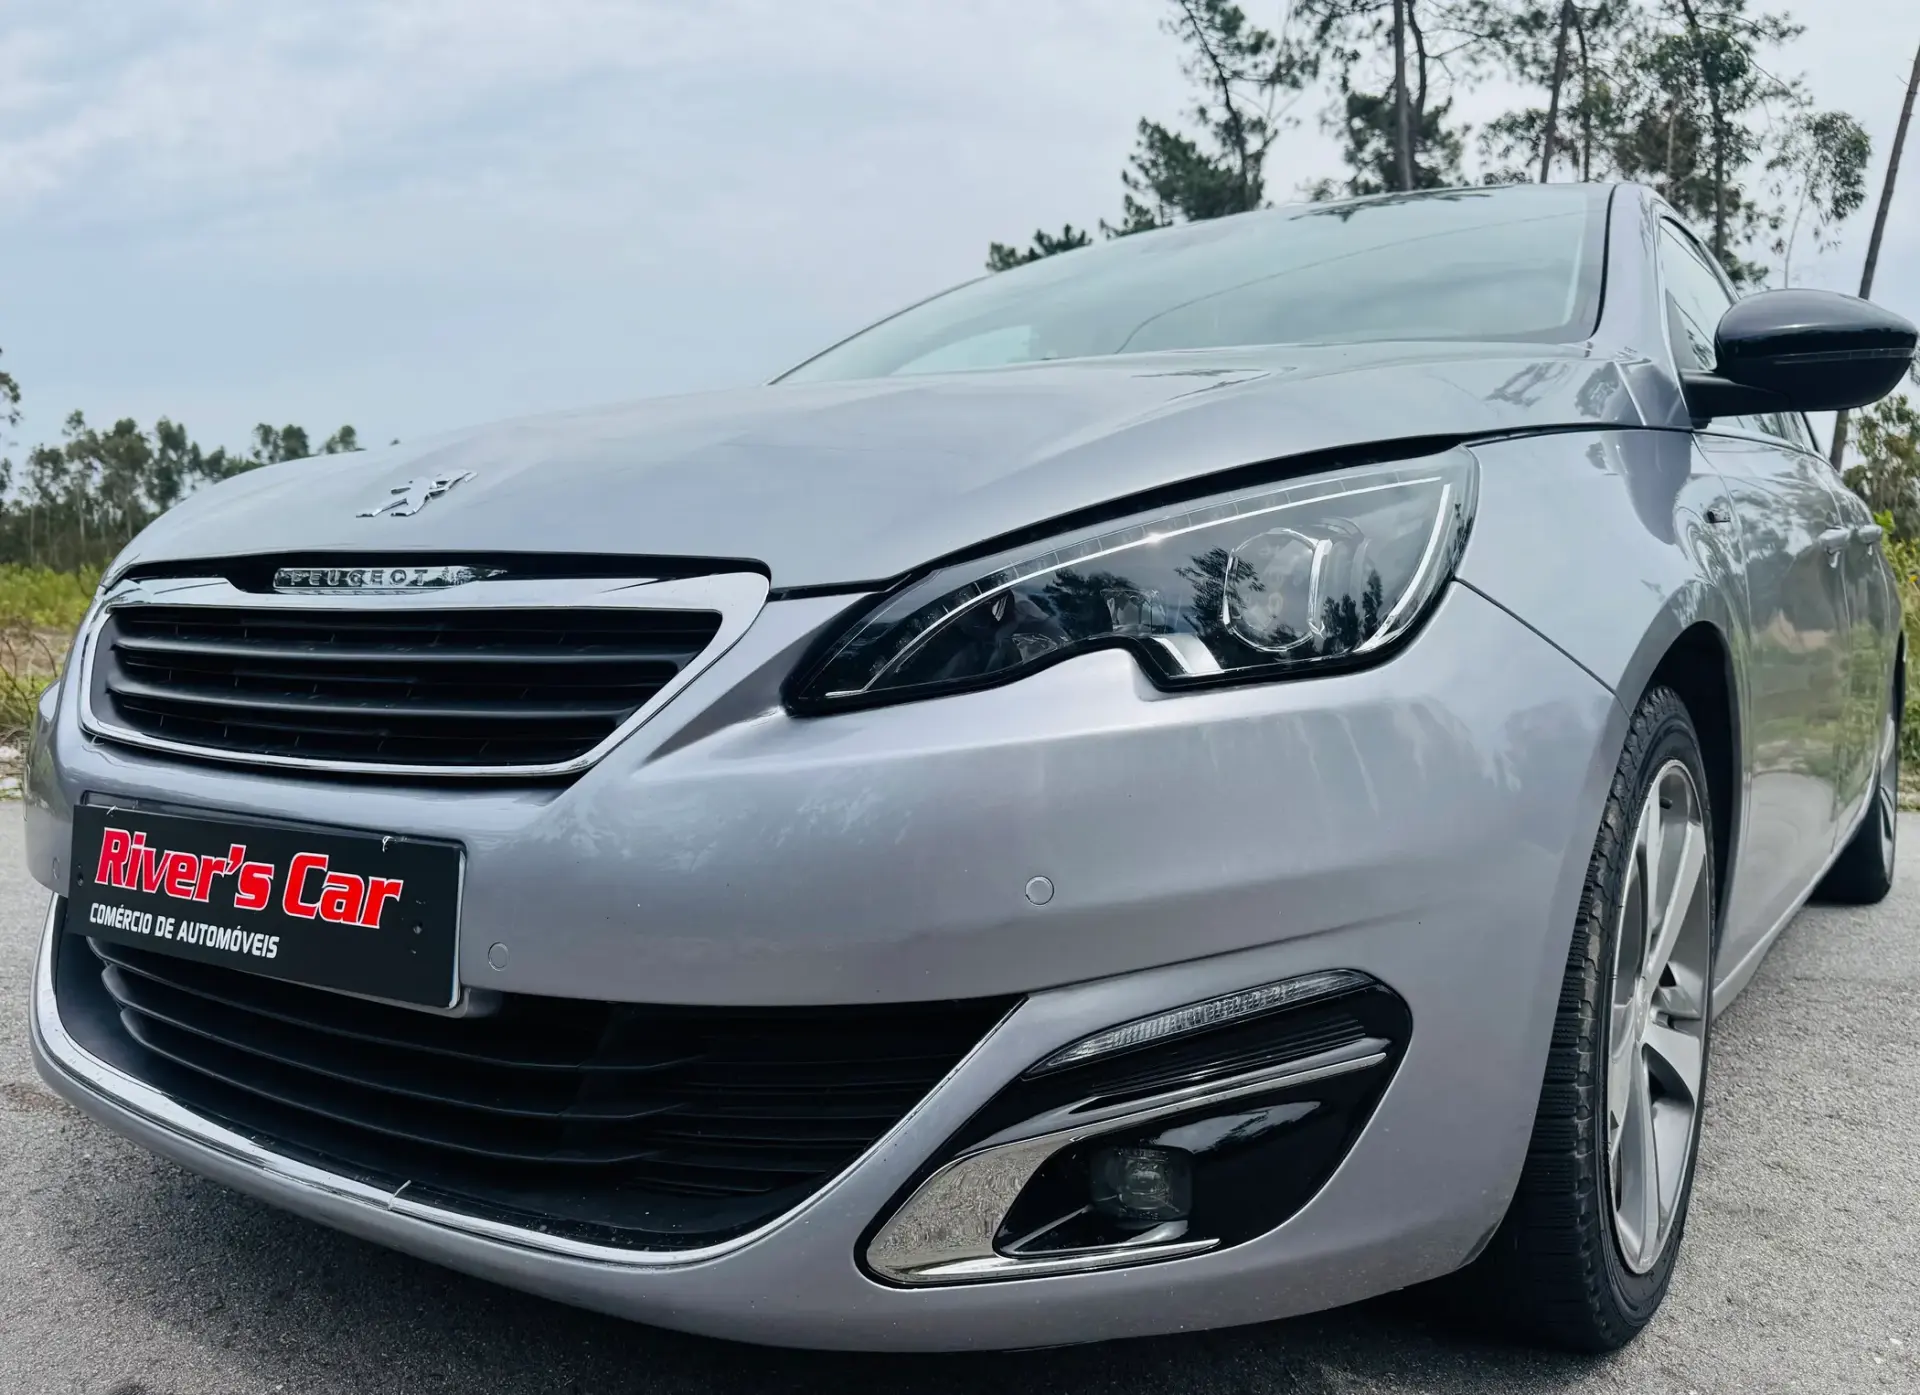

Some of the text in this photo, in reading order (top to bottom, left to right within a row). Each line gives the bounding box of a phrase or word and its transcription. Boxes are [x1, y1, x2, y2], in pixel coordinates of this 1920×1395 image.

[289, 568, 429, 587] PEUGEOT
[94, 827, 404, 929] River's Car
[89, 903, 280, 959] COMÉRCIO DE AUTOMÓVEIS
